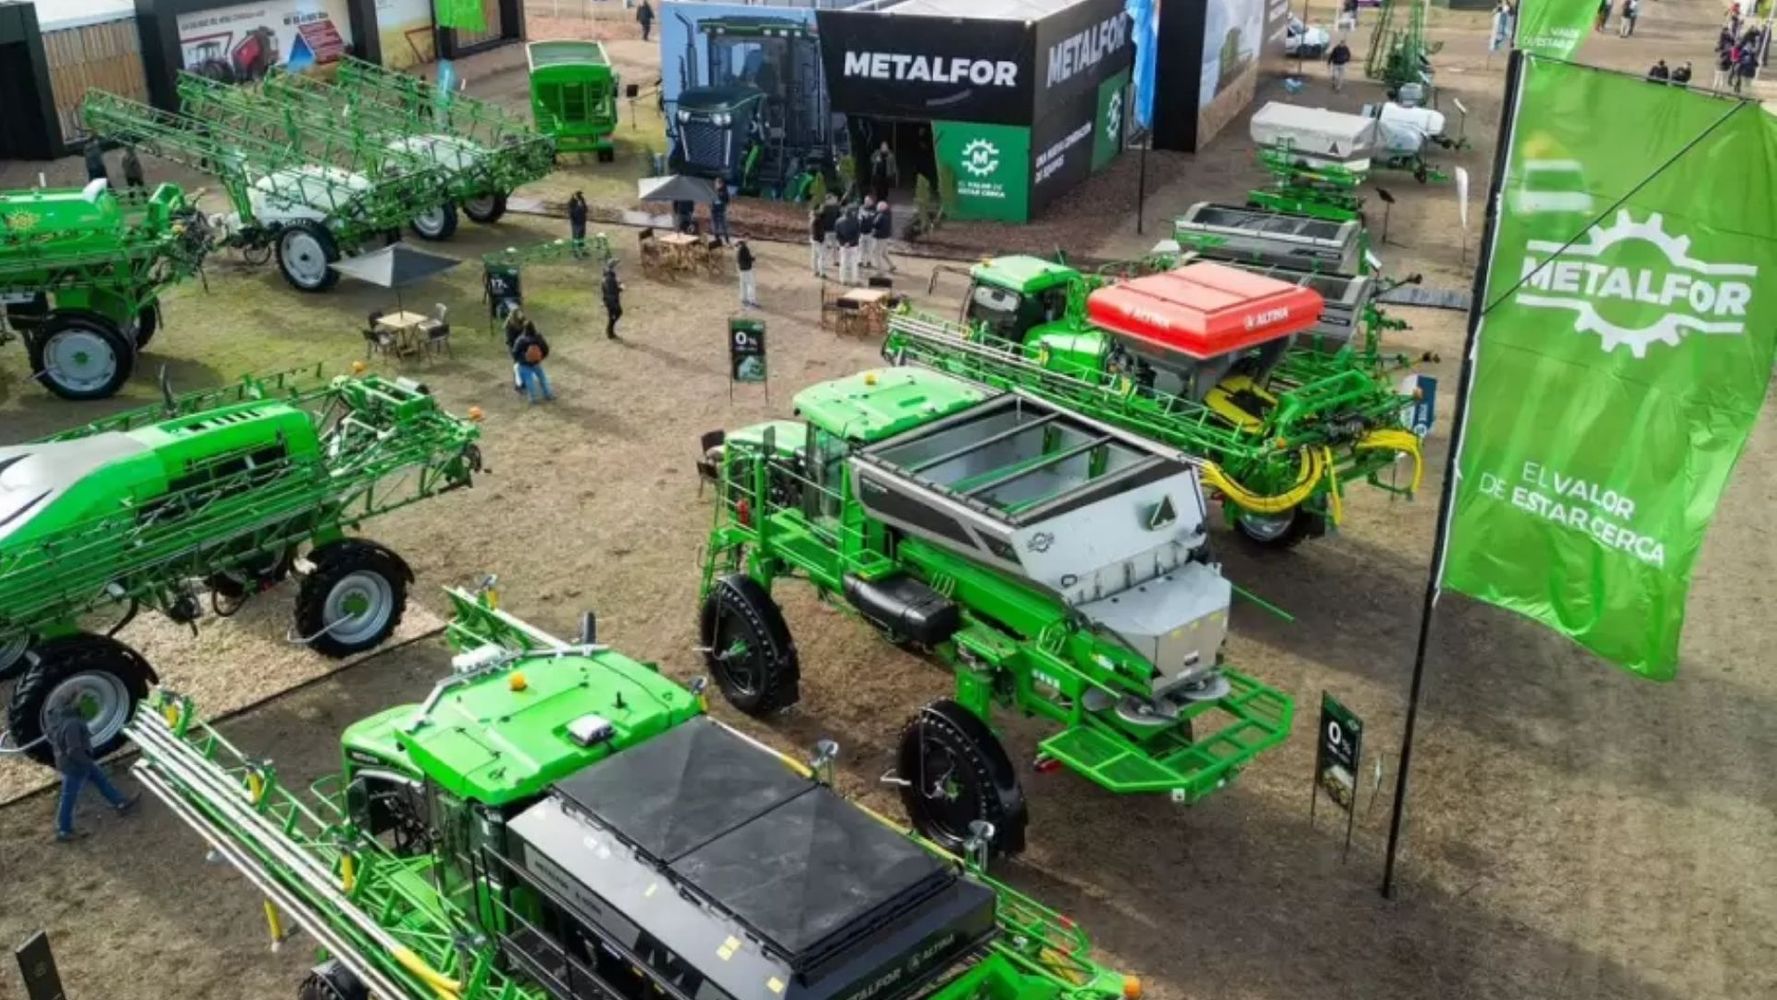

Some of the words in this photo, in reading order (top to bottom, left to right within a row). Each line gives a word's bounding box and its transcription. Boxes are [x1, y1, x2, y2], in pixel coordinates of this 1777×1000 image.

[844, 51, 1018, 87] METALFOR
[973, 150, 988, 164] M
[1519, 256, 1752, 316] METALFOR
[1522, 460, 1548, 488] EL
[1553, 472, 1636, 520] VALOR
[1478, 472, 1507, 500] DE
[1511, 486, 1589, 532] ESTAR
[1589, 515, 1666, 569] CERCA
